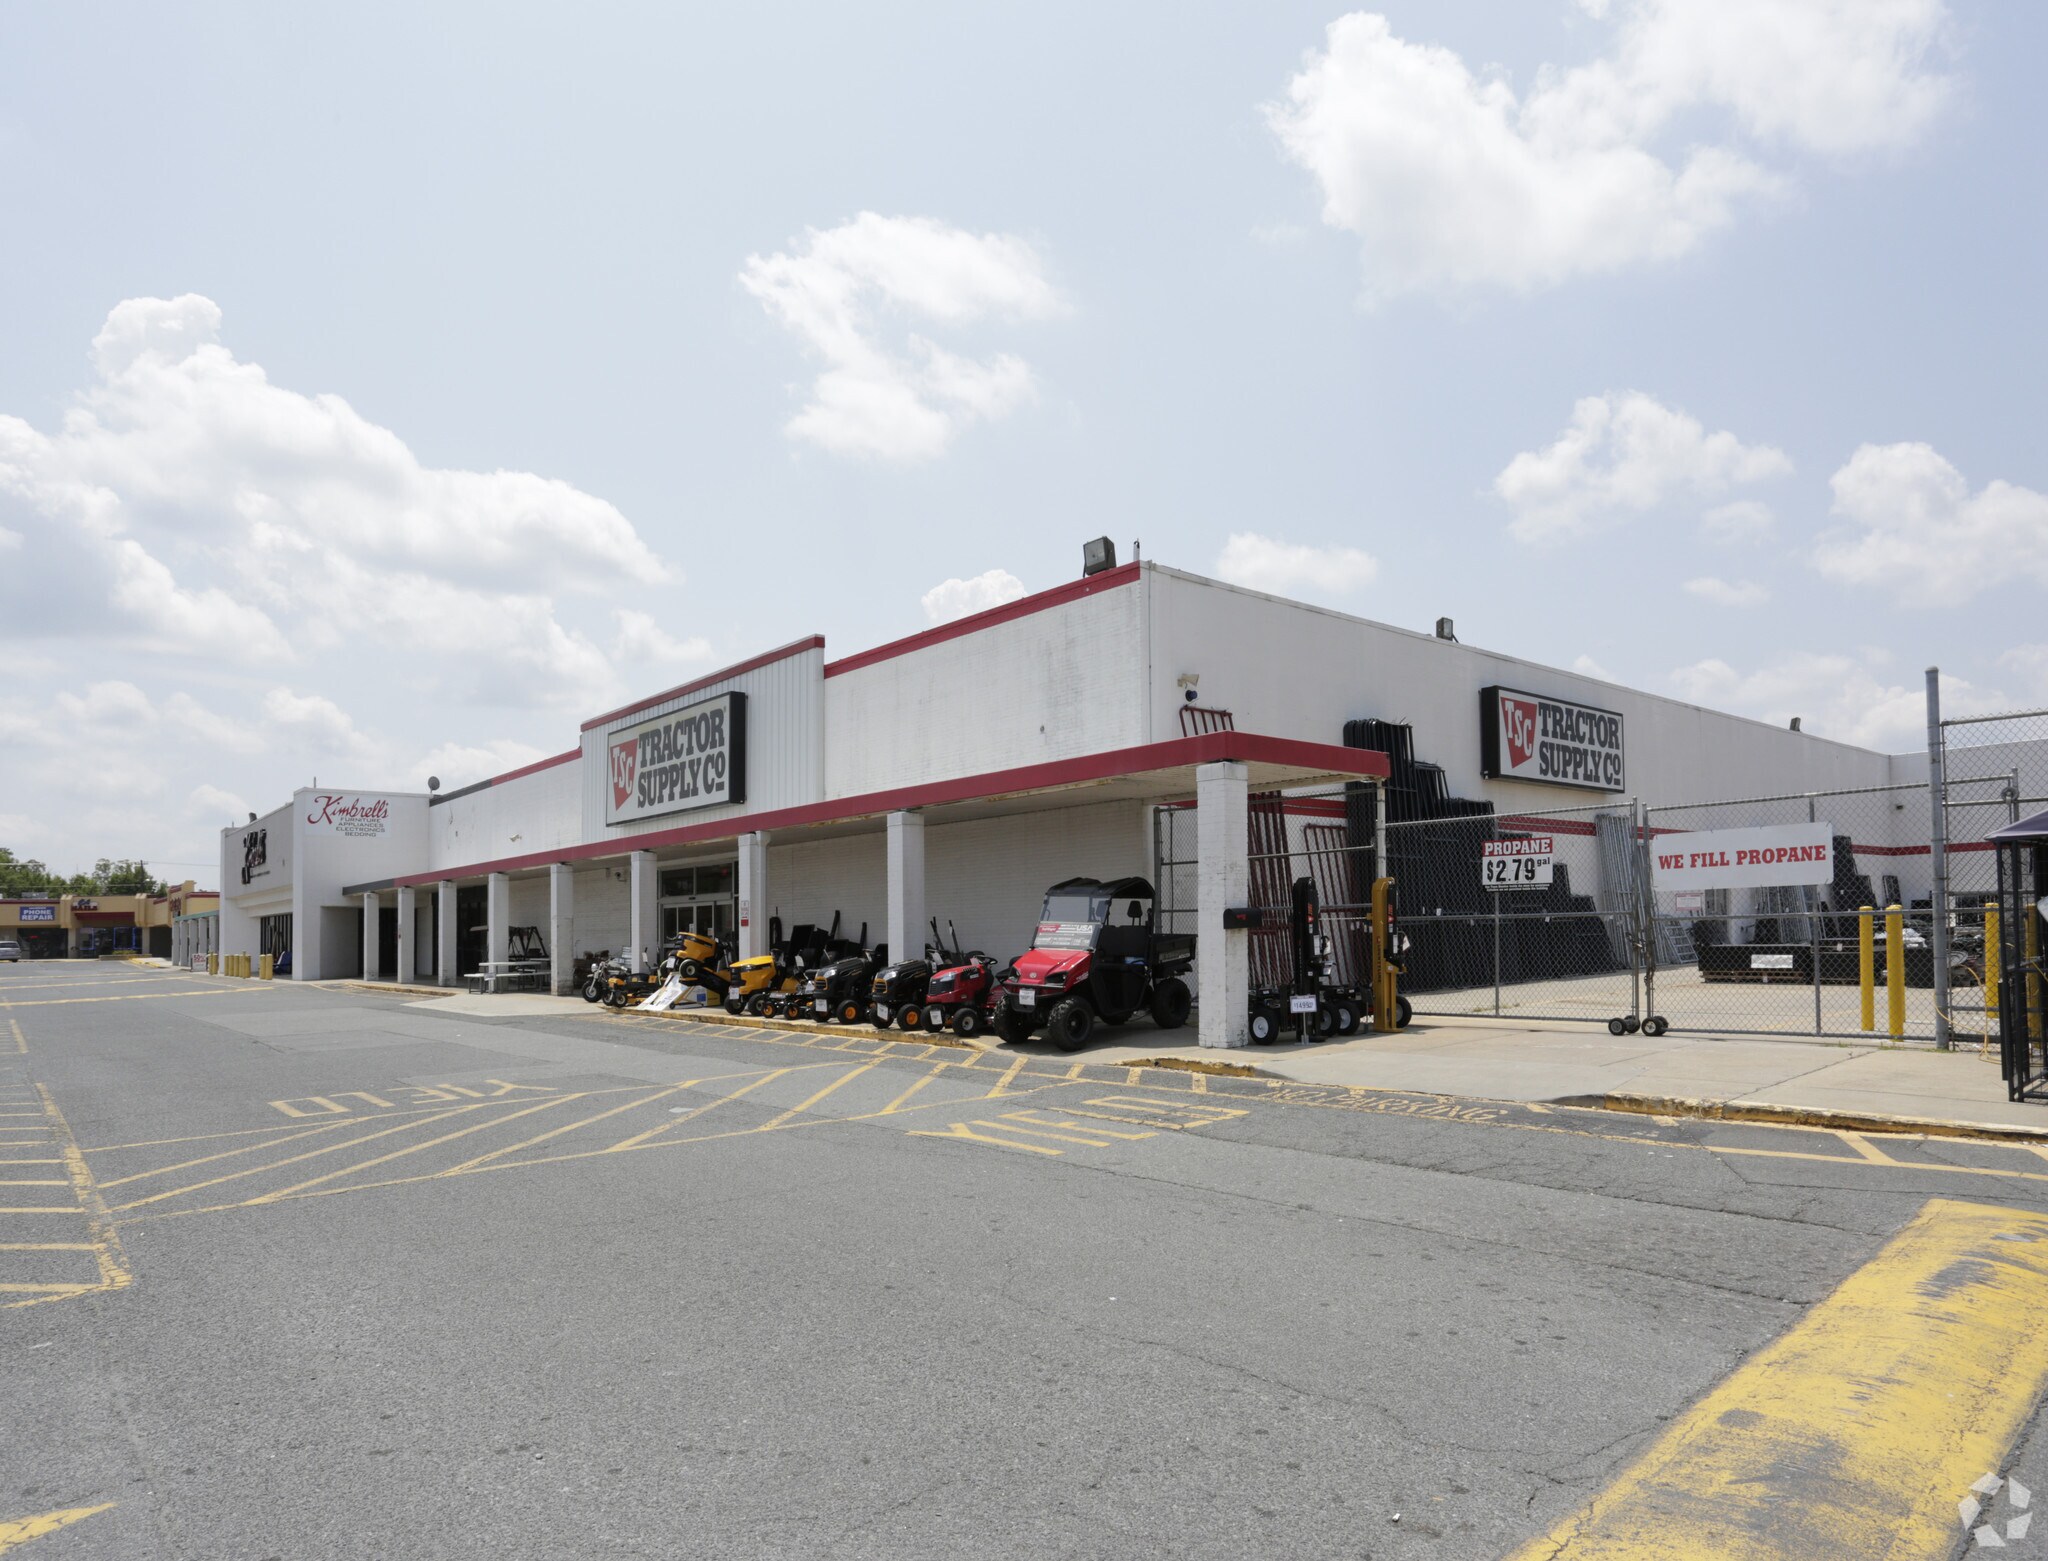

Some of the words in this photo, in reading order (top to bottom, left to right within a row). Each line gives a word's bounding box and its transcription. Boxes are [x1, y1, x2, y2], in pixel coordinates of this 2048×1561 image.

[639, 708, 725, 768] TRACTOR
[1505, 700, 1532, 757] TSC
[1538, 702, 1620, 750] TRACTOR
[612, 747, 632, 795] TSC
[638, 757, 701, 808] SUPPLY
[1539, 740, 1602, 783] SUPPLY
[307, 795, 388, 825] Kimbrell's
[1484, 839, 1551, 856] PROPANE
[1487, 857, 1535, 882] $2.79
[1537, 857, 1550, 867] gal
[1658, 854, 1684, 870] WE
[1689, 851, 1730, 868] FILL
[1736, 845, 1826, 866] PROPANE
[905, 1095, 1250, 1156] YIELD
